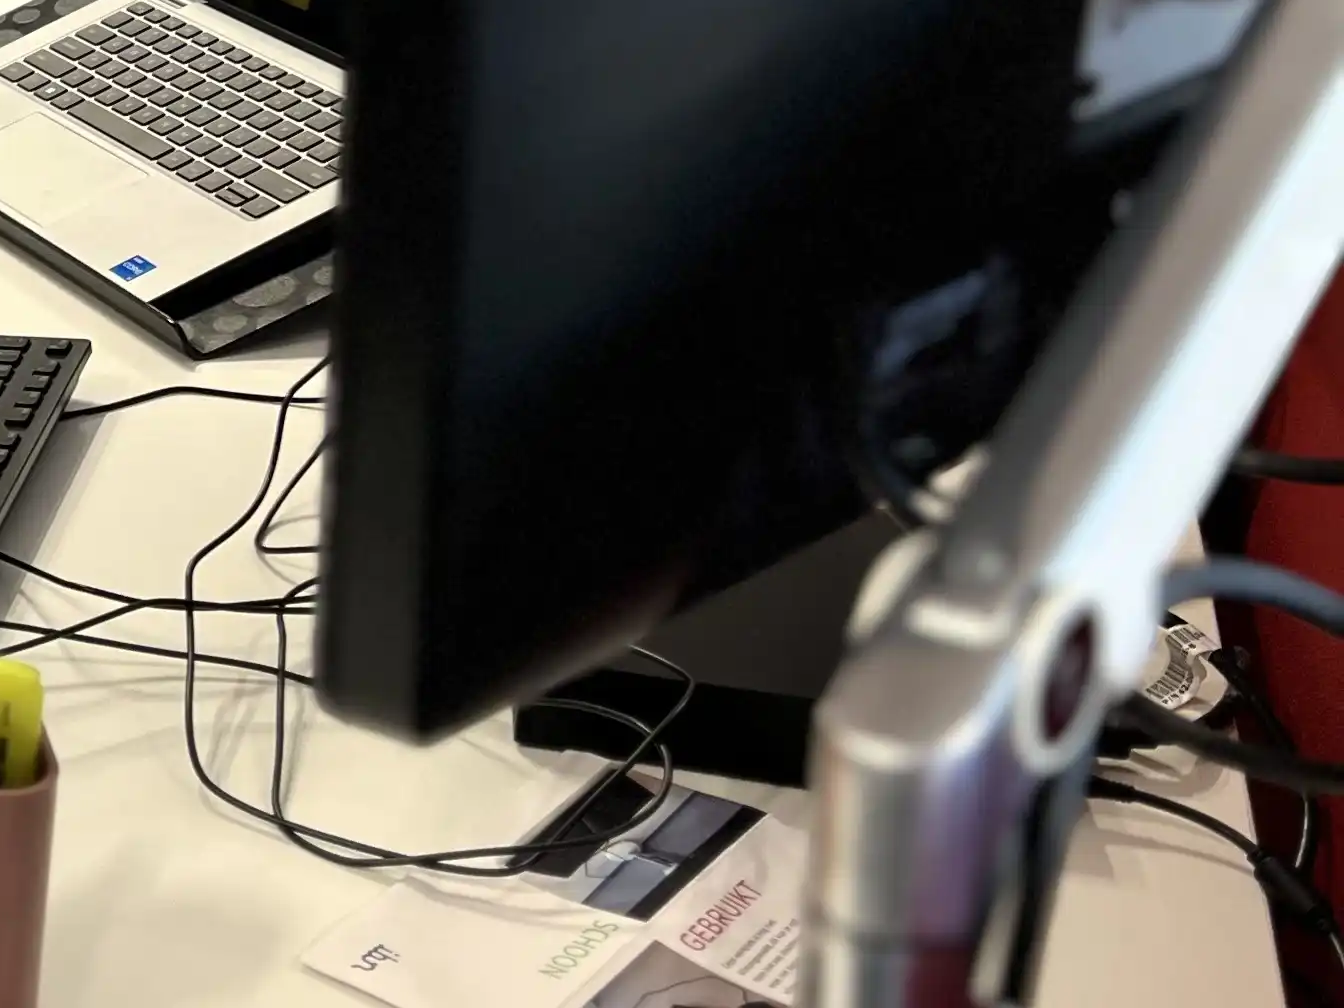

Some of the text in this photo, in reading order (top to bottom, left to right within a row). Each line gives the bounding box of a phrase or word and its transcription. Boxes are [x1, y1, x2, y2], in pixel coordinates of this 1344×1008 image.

[679, 879, 763, 952] GEBRUIKT
[350, 943, 401, 972] ibn
[537, 919, 620, 980] SCHOON
